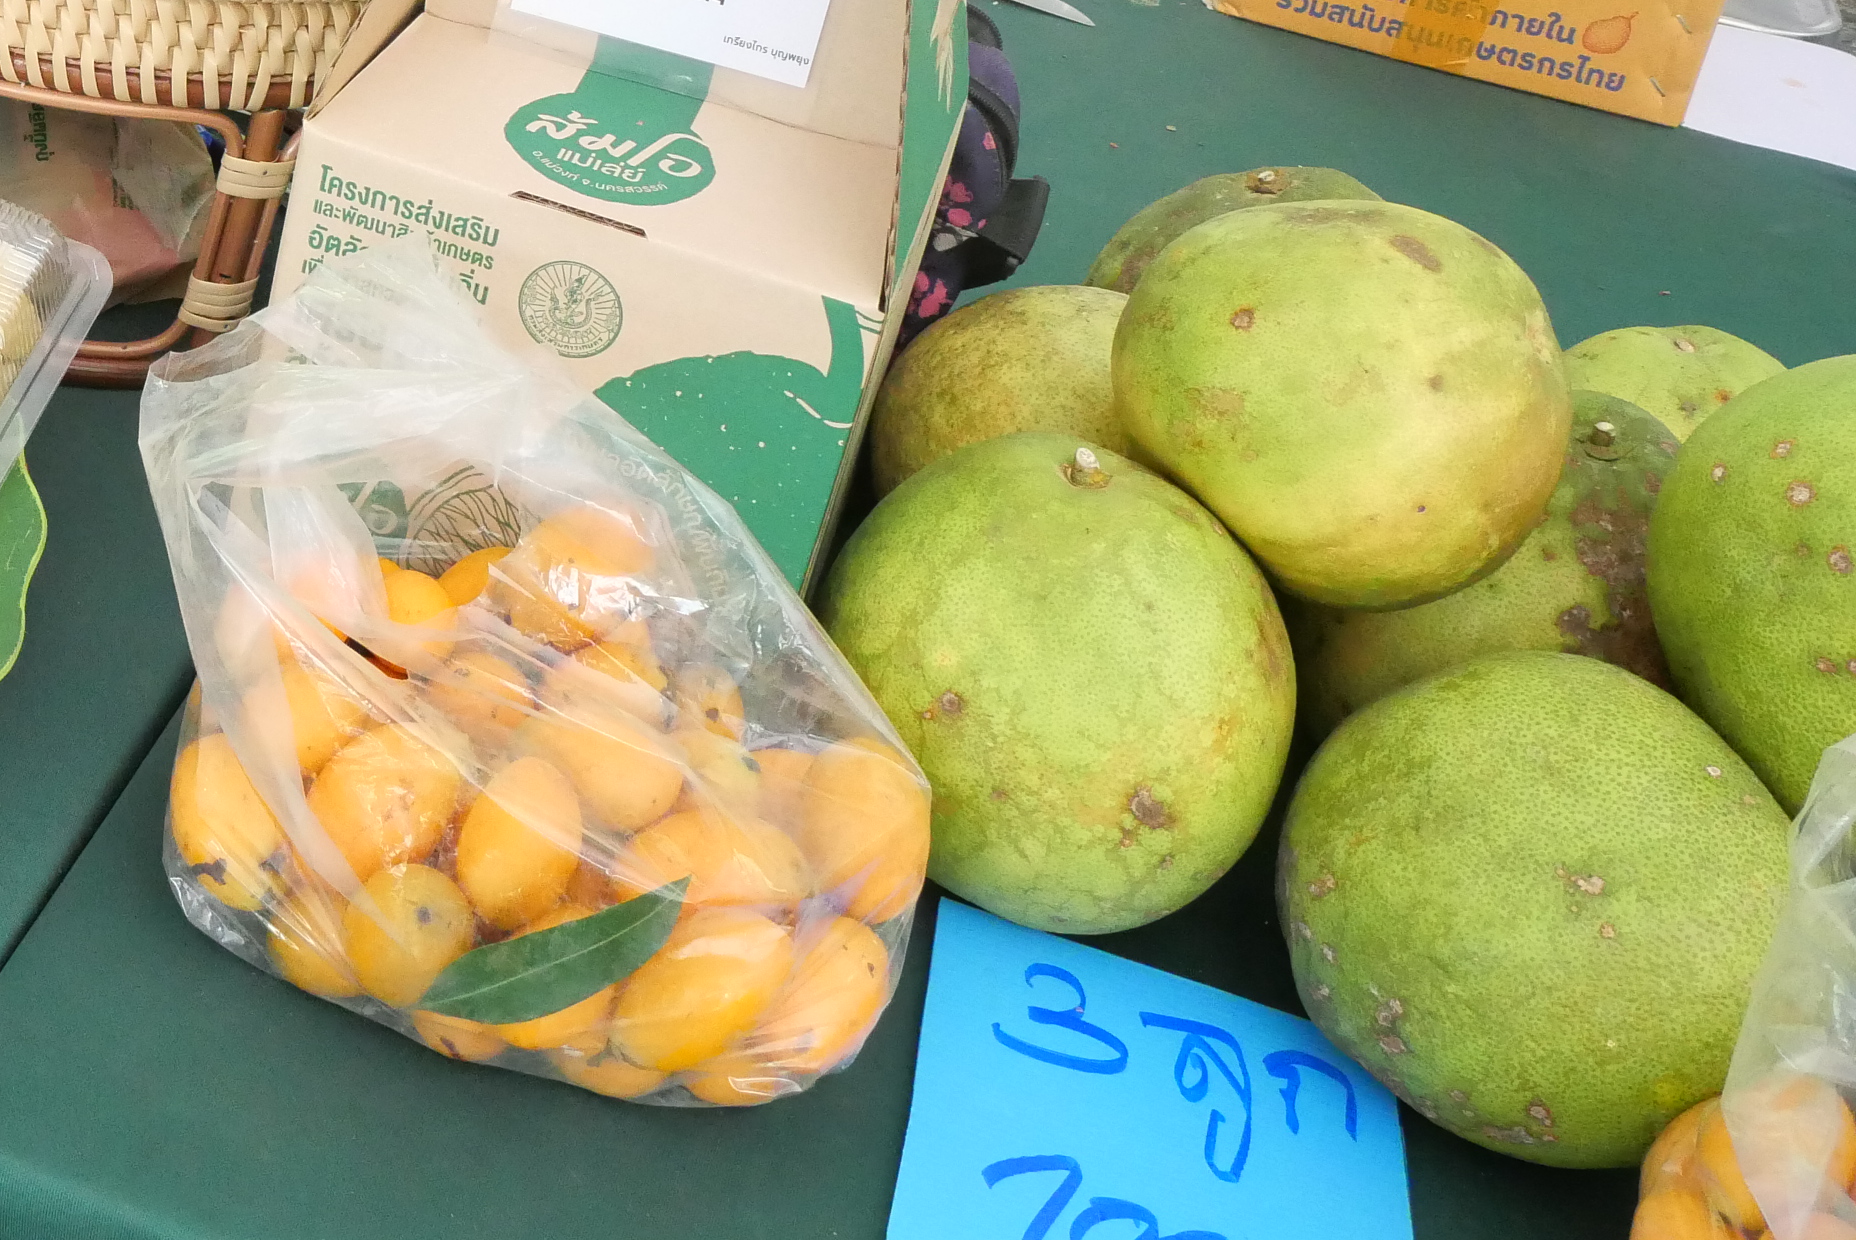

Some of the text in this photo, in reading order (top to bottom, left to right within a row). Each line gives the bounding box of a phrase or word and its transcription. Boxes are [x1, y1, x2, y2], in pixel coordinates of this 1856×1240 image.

[524, 110, 703, 178] ส้มโอ
[319, 164, 500, 247] โครงการส่งเสริม
